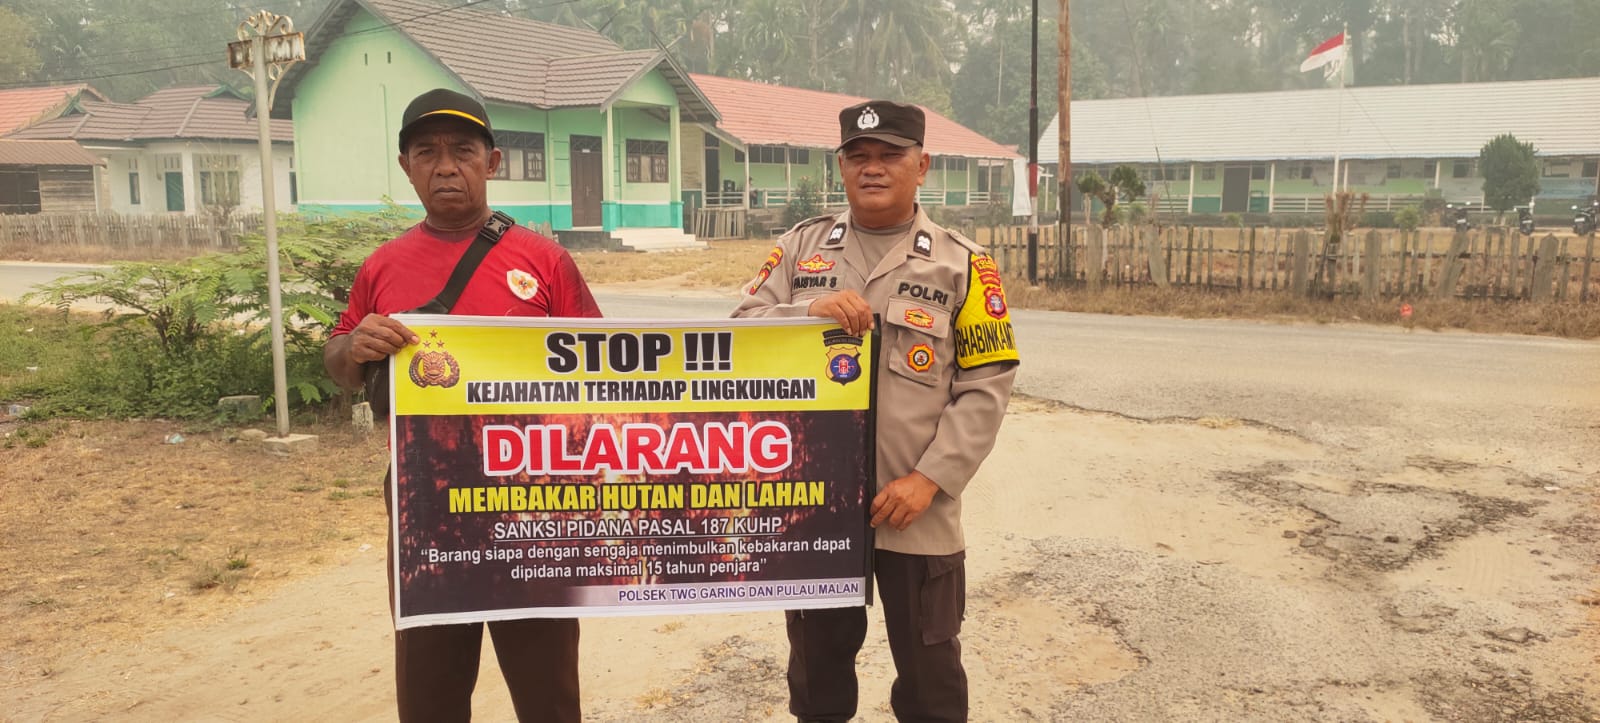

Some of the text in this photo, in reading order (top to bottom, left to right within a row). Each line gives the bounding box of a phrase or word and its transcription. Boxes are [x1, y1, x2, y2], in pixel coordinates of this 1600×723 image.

[898, 282, 949, 306] POLRI
[547, 332, 732, 373] STOP !!!
[467, 379, 816, 403] KEJAHATAN TERHADAP LINGKUNGAN
[484, 423, 791, 475] DILARANG
[449, 481, 825, 513] MEMBAKAR HUTAN DAN LAHAN
[494, 516, 783, 539] SANKSI PIDANA PASAL 187 KUHP
[421, 537, 851, 564] “Barang siapa dengan sengaja menimbulkan kebakaran dapat
[511, 558, 767, 582] dipidana maksimal 15 tahun penjara”
[619, 583, 859, 601] POLSEK TWG GARING DAN PULAU MALAN
